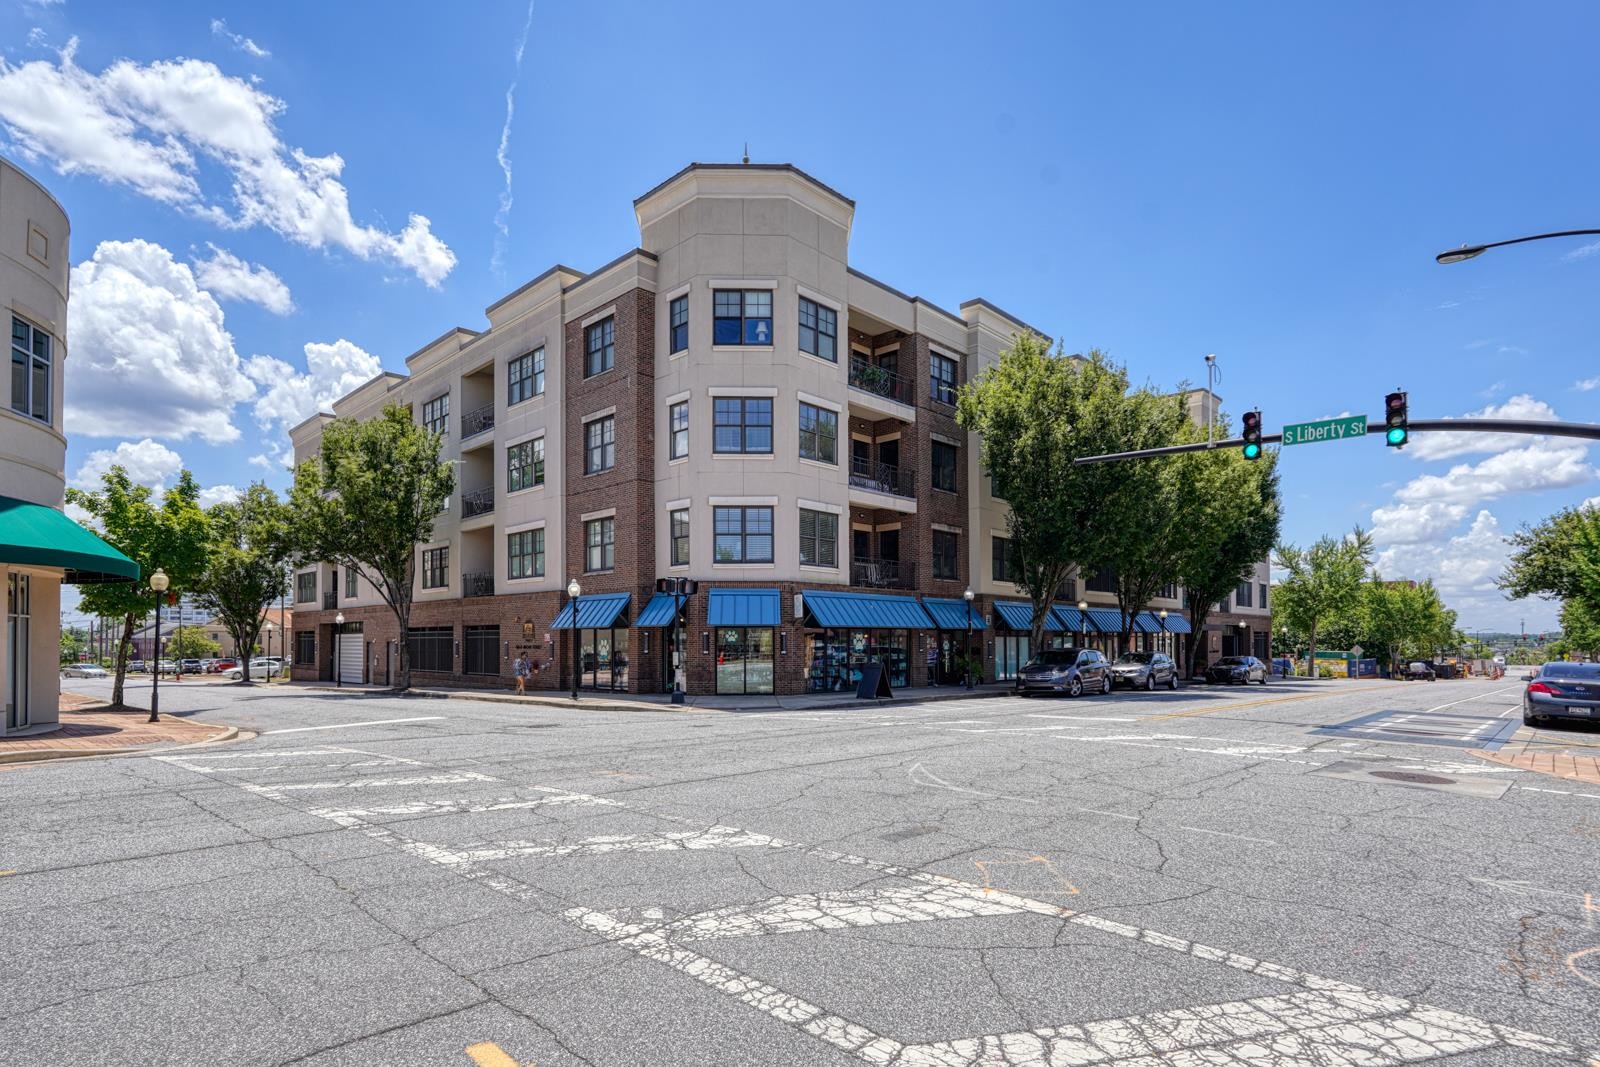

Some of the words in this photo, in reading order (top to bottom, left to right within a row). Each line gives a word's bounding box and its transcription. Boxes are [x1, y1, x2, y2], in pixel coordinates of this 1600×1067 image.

[1285, 431, 1293, 443] S
[1296, 422, 1346, 442] Liberty
[1350, 421, 1365, 435] St
